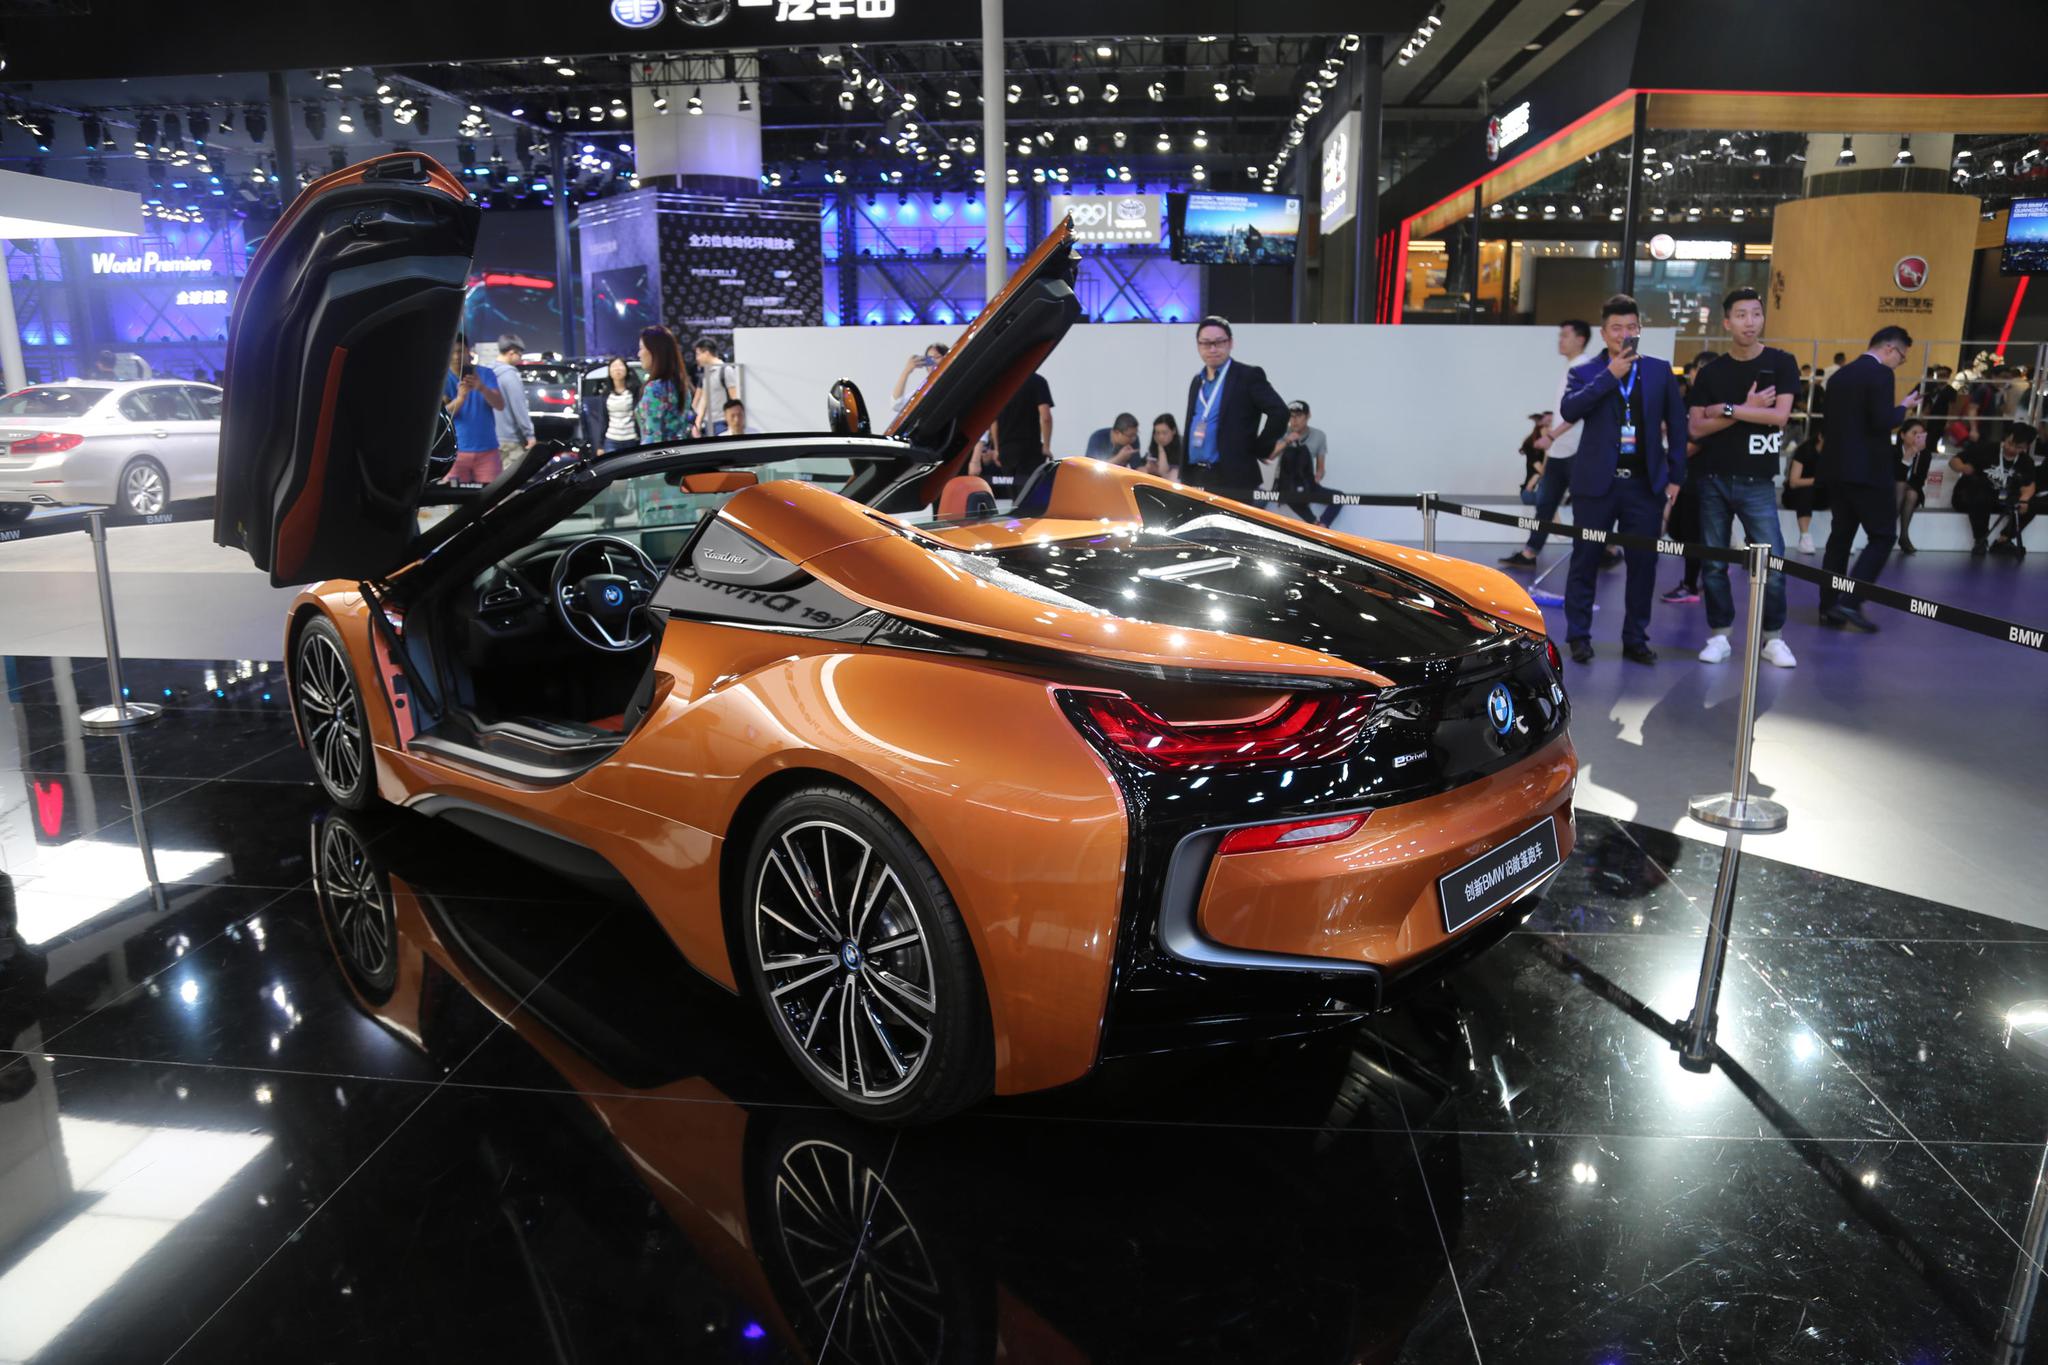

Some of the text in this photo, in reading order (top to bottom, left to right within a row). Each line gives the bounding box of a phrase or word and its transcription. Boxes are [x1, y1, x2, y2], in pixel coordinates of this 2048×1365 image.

[92, 251, 213, 274] World Premiere
[992, 476, 1014, 484] BMW
[1253, 490, 1280, 501] BMW
[1332, 495, 1360, 505] BMW
[147, 514, 173, 524] BMW
[1461, 506, 1480, 519] BMW
[1518, 517, 1540, 531] BMW
[0, 529, 21, 541] MW
[1582, 528, 1607, 543] BMW
[1656, 540, 1684, 555] BMW
[1769, 556, 1784, 571] MW
[1832, 576, 1856, 593] BMW
[1910, 599, 1938, 618] BMW
[2009, 626, 2044, 648] BMW
[1465, 864, 1505, 901] 创新BMW
